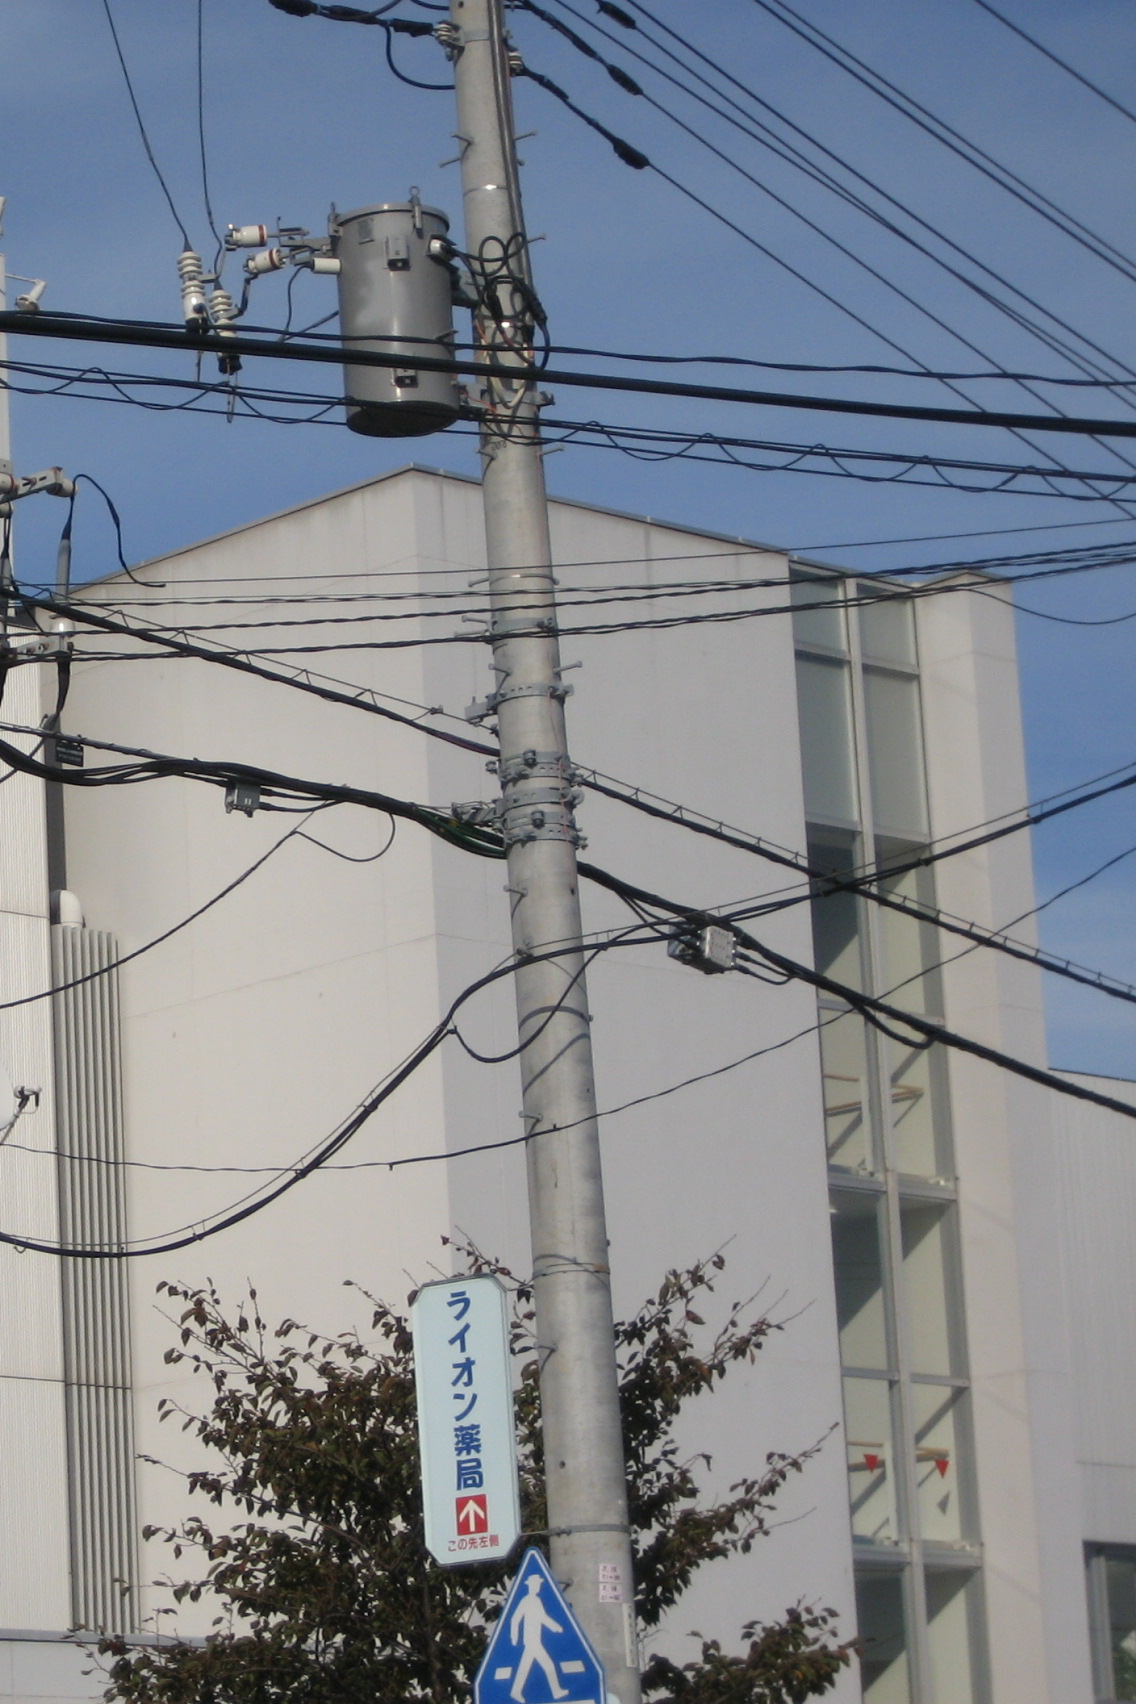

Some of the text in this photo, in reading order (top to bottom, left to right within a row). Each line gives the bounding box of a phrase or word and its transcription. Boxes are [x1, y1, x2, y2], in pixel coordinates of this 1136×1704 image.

[446, 1290, 484, 1491] ライオン薬局
[447, 1534, 500, 1552] この先左側
